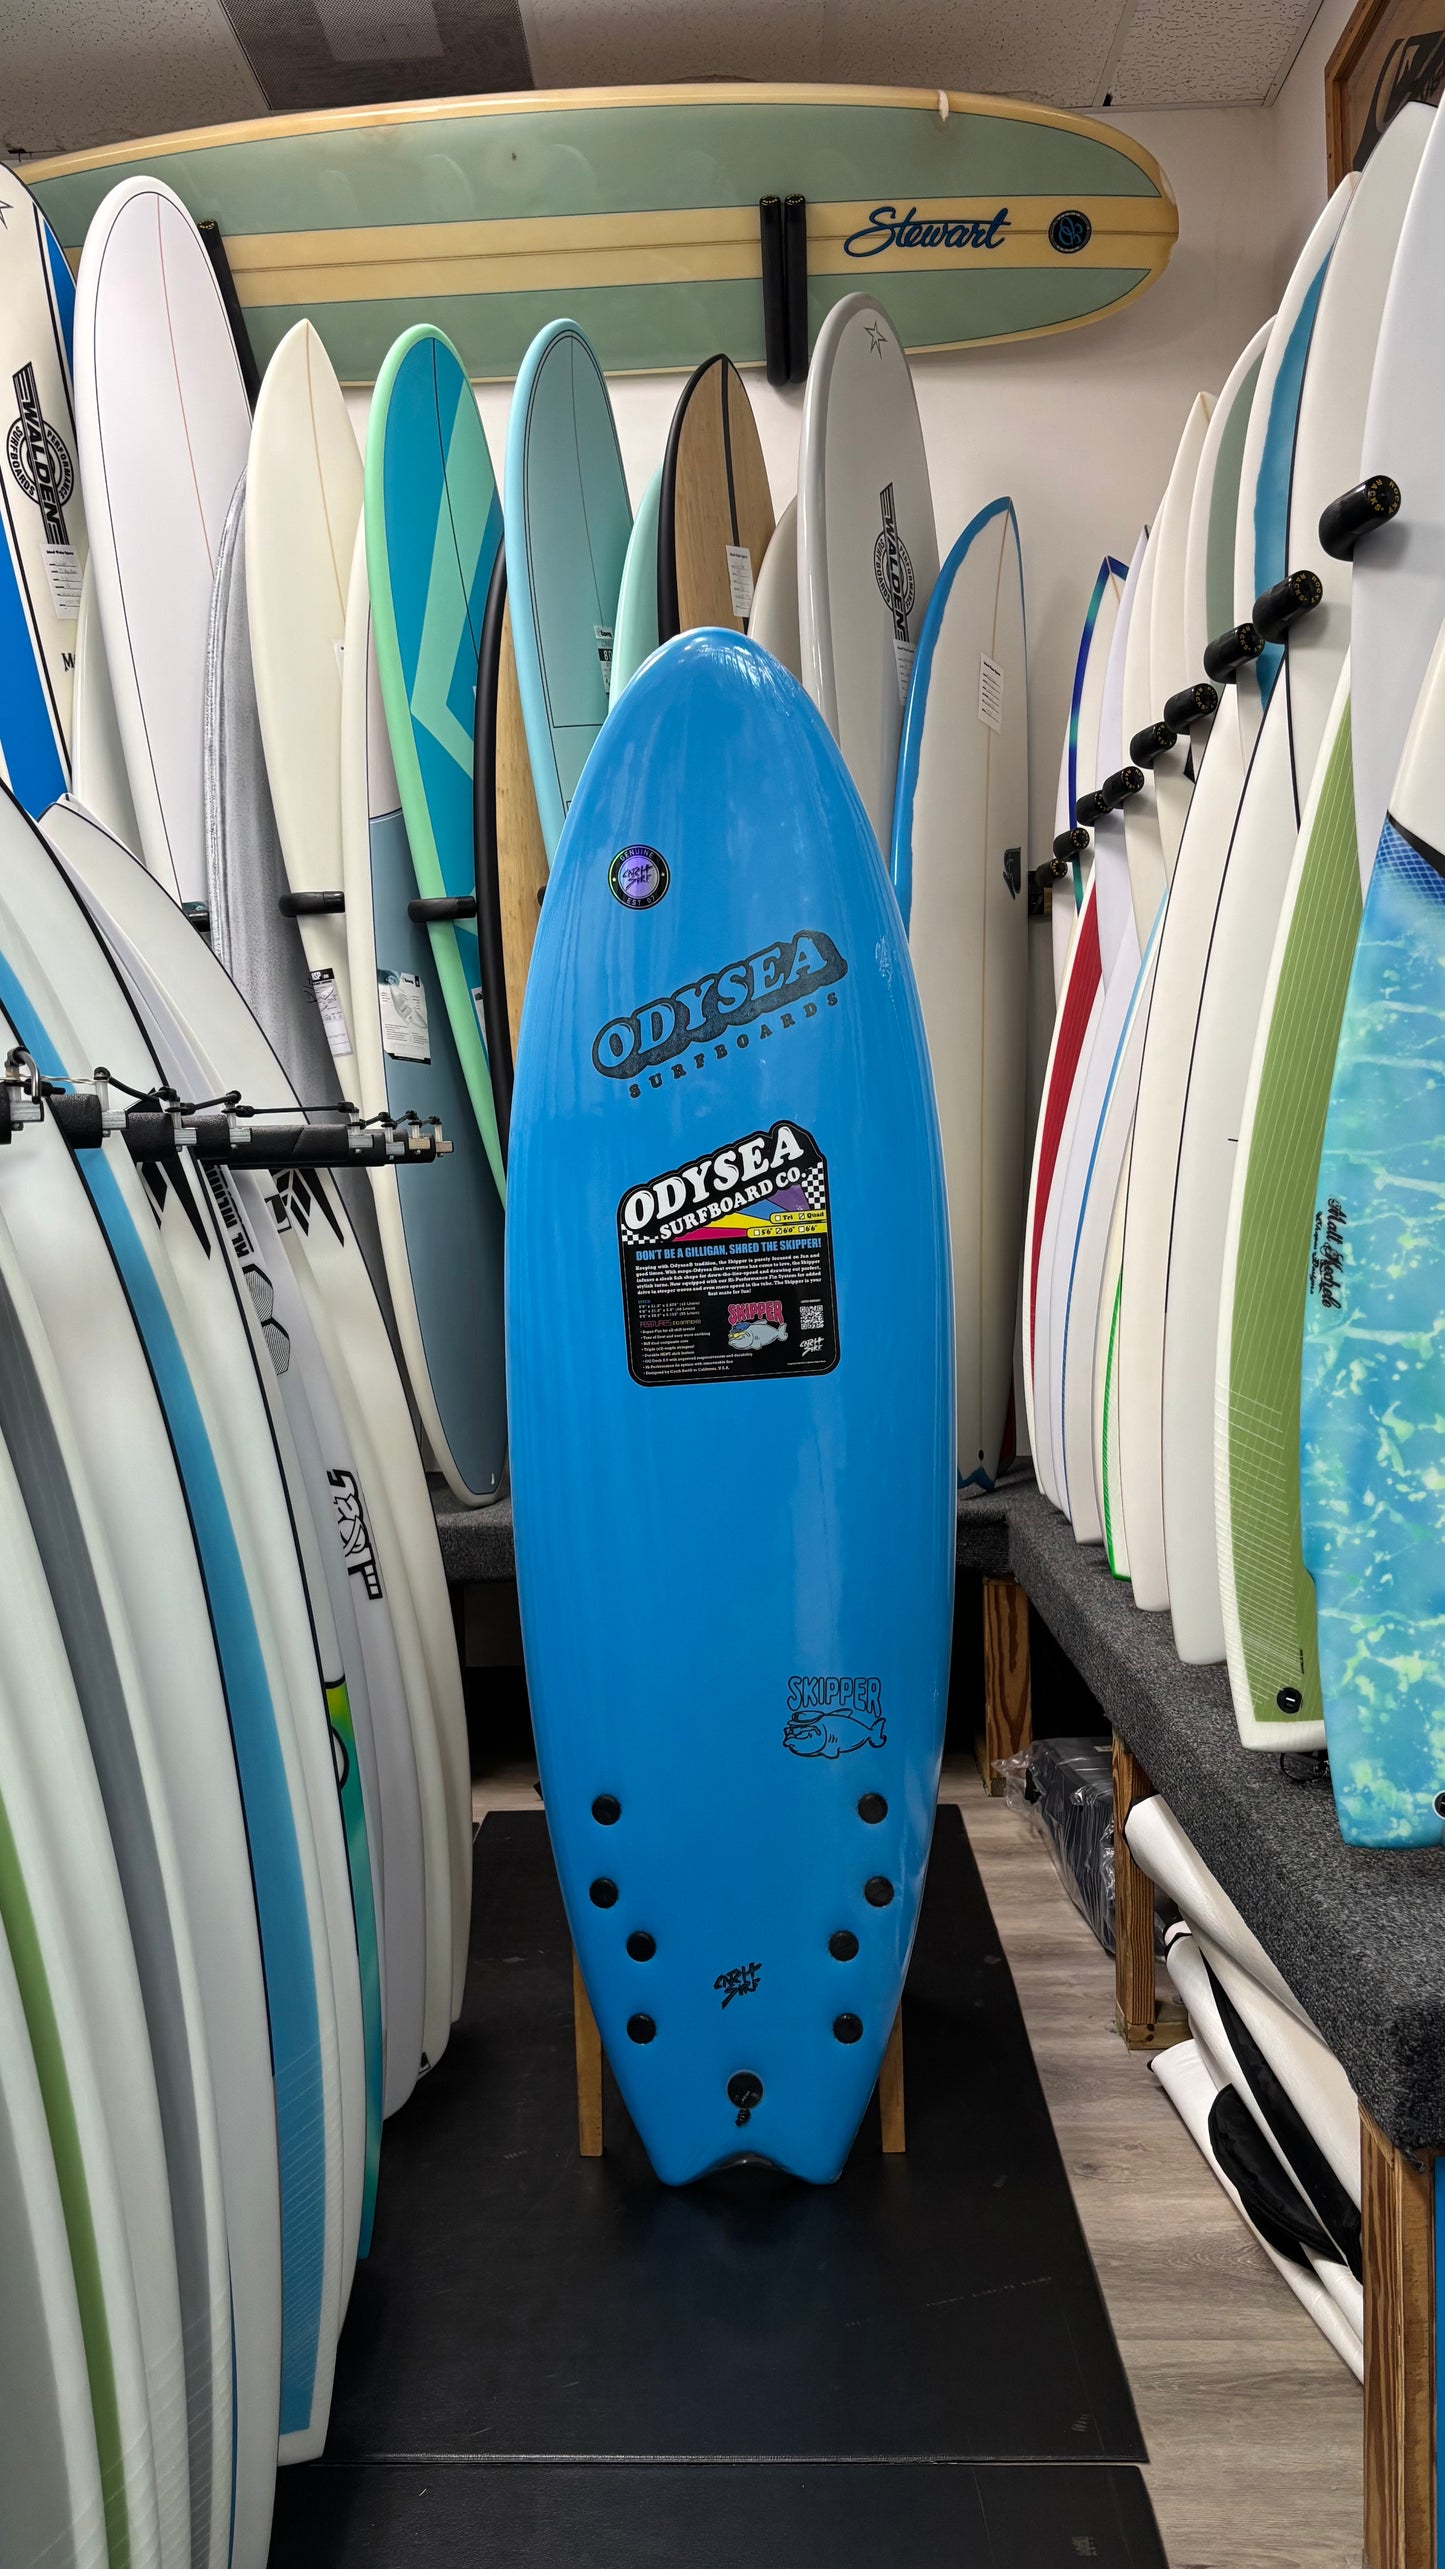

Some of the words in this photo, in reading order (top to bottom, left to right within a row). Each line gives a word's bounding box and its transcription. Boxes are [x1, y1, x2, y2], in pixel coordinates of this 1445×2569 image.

[843, 206, 1012, 258] Stewart
[9, 425, 36, 496] SURFBOARDS
[13, 372, 68, 542] WALDEN
[46, 429, 73, 500] PERFORMANCE
[875, 538, 892, 603] SURFBOARDS
[880, 490, 909, 639] WALDEN
[620, 848, 655, 861] GENUINE
[626, 898, 641, 906] EST
[595, 932, 835, 1072] ODYSEA
[628, 992, 839, 1099] SURFBOARDS
[624, 1126, 804, 1230] ODYSEA
[659, 1178, 773, 1240] SURFBOARD
[775, 1166, 807, 1188] CO.
[636, 1249, 662, 1261] DON'T
[664, 1248, 676, 1258] BE
[677, 1248, 684, 1258] A
[685, 1244, 728, 1258] GILLIGAN,
[729, 1242, 759, 1254] SHRED
[760, 1241, 778, 1252] THE
[779, 1237, 822, 1251] SKIPPER!
[1327, 1197, 1347, 1245] Matt
[727, 1299, 784, 1325] SKIPPER
[786, 1675, 882, 1719] SKIPPER
